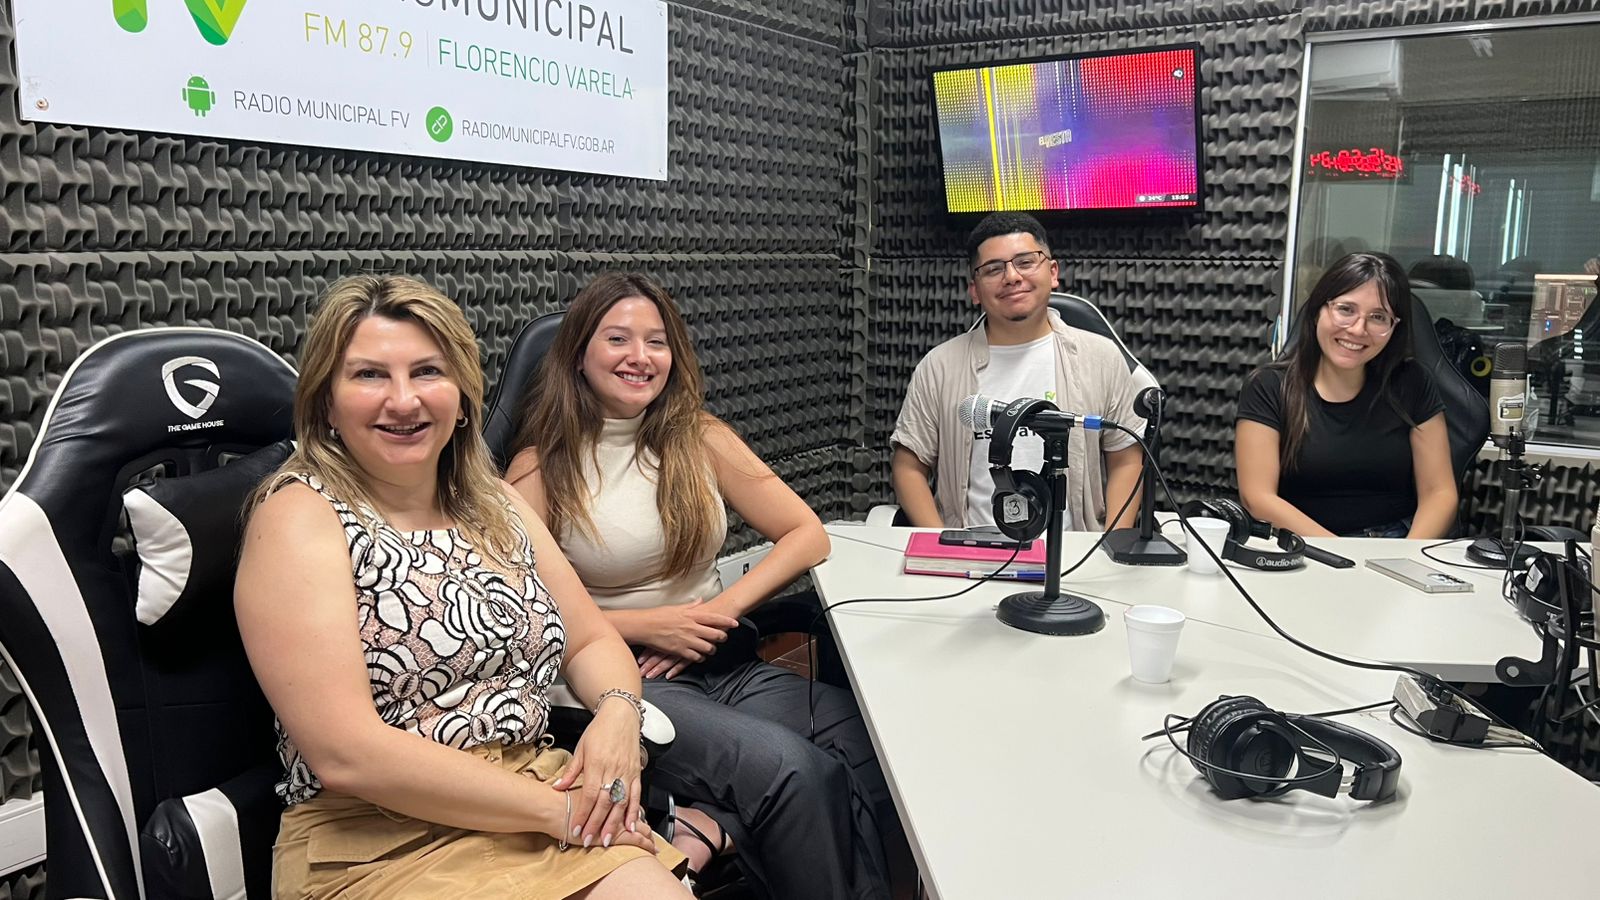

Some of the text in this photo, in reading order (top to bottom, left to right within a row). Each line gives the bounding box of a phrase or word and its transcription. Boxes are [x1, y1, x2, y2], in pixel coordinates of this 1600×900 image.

[304, 12, 413, 59] FM 87.9
[438, 38, 634, 101] FLORENCIO VARELA
[233, 90, 410, 129] RADIO MUNICIPAL FV
[461, 119, 615, 155] RADIOMUNICIPALFV.GOB.AR
[167, 419, 224, 433] THE GAME HOUSE
[1009, 499, 1021, 516] 3
